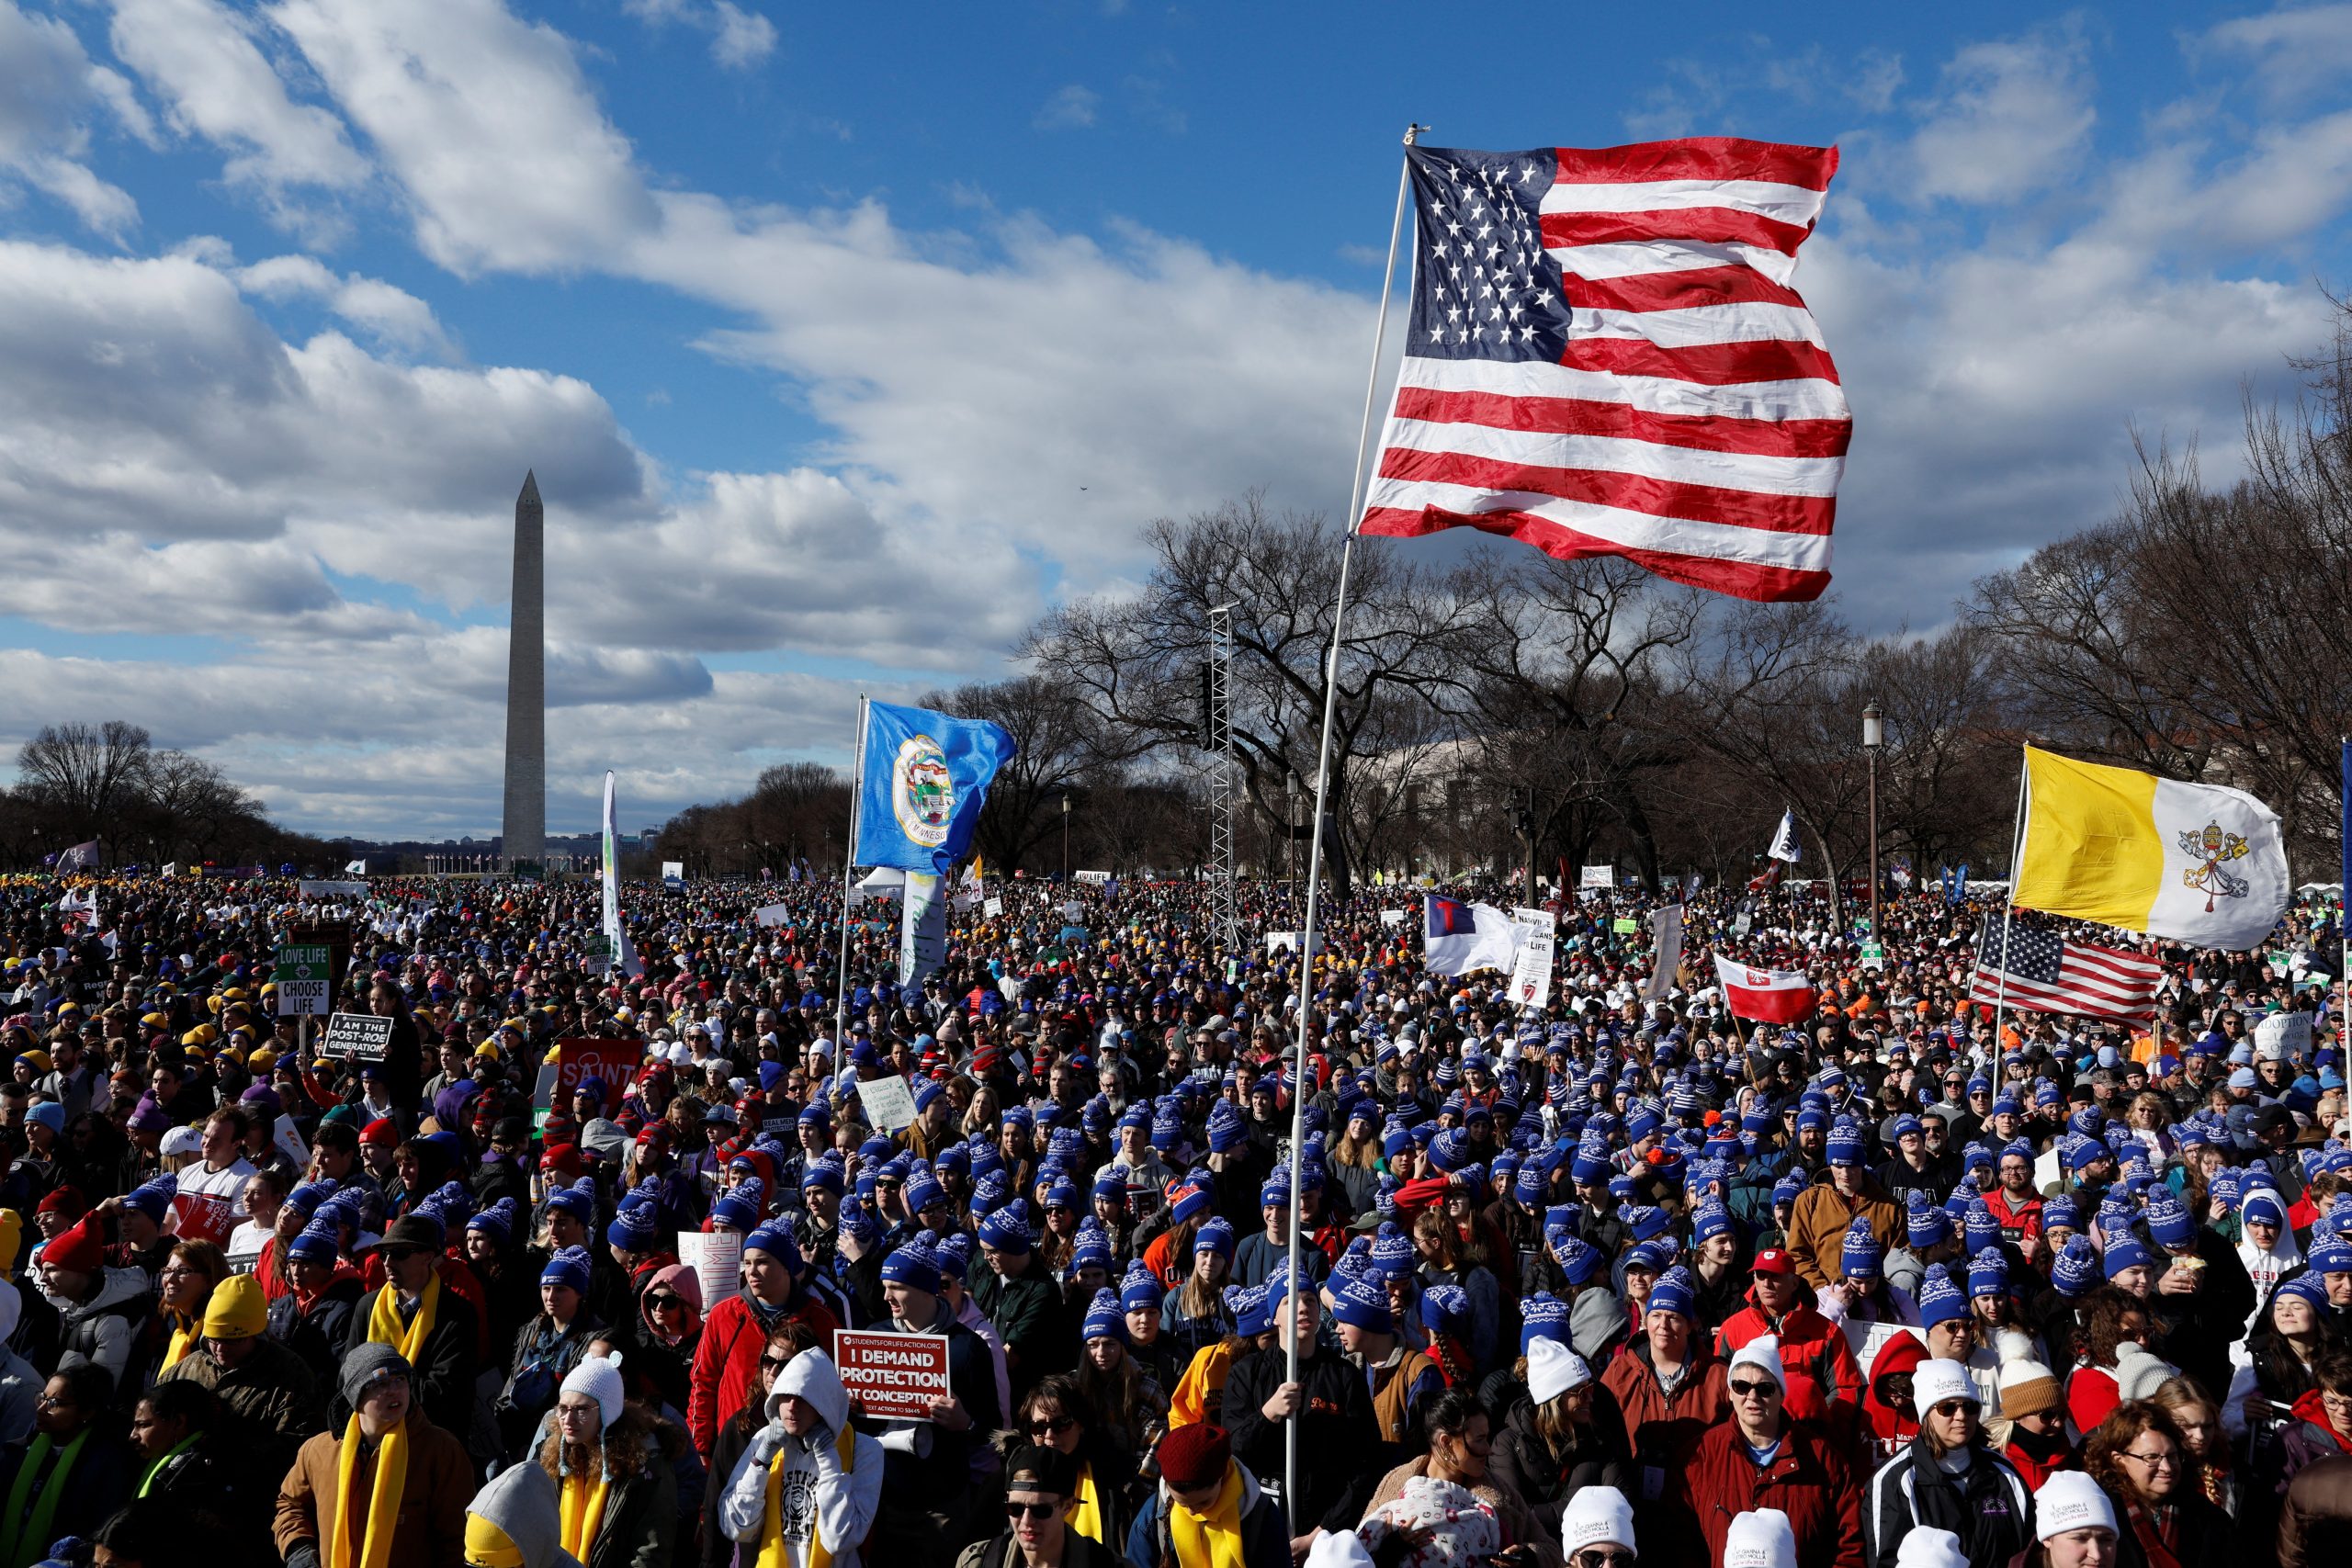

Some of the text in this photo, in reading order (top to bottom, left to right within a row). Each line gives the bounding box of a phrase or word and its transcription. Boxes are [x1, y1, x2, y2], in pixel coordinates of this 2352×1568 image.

[912, 824, 945, 840] MINNESO
[1518, 915, 1551, 928] NASHVIE
[1530, 941, 1547, 952] LIFE
[280, 948, 326, 964] LOVE LIFE
[589, 955, 609, 964] CHOOSE
[595, 964, 605, 973] LIFE
[84, 980, 107, 990] Regr
[284, 982, 323, 997] CHOOSE
[294, 998, 314, 1013] LIFE
[343, 1021, 360, 1030] AM
[365, 1023, 386, 1032] THE
[330, 1030, 387, 1043] POST-ROE
[329, 1041, 383, 1053] GENERATION
[562, 1063, 636, 1088] SAINT
[763, 1119, 780, 1127] REAL
[1894, 1186, 1938, 1208] UA
[243, 1262, 259, 1273] TH
[702, 1234, 738, 1309] TIME
[852, 1338, 941, 1349] STUDENTSFORLIFEACTION.ORG
[851, 1348, 933, 1367] I DEMAND
[840, 1367, 945, 1388] PROTECTION
[847, 1387, 941, 1404] AT CONCEPTIO
